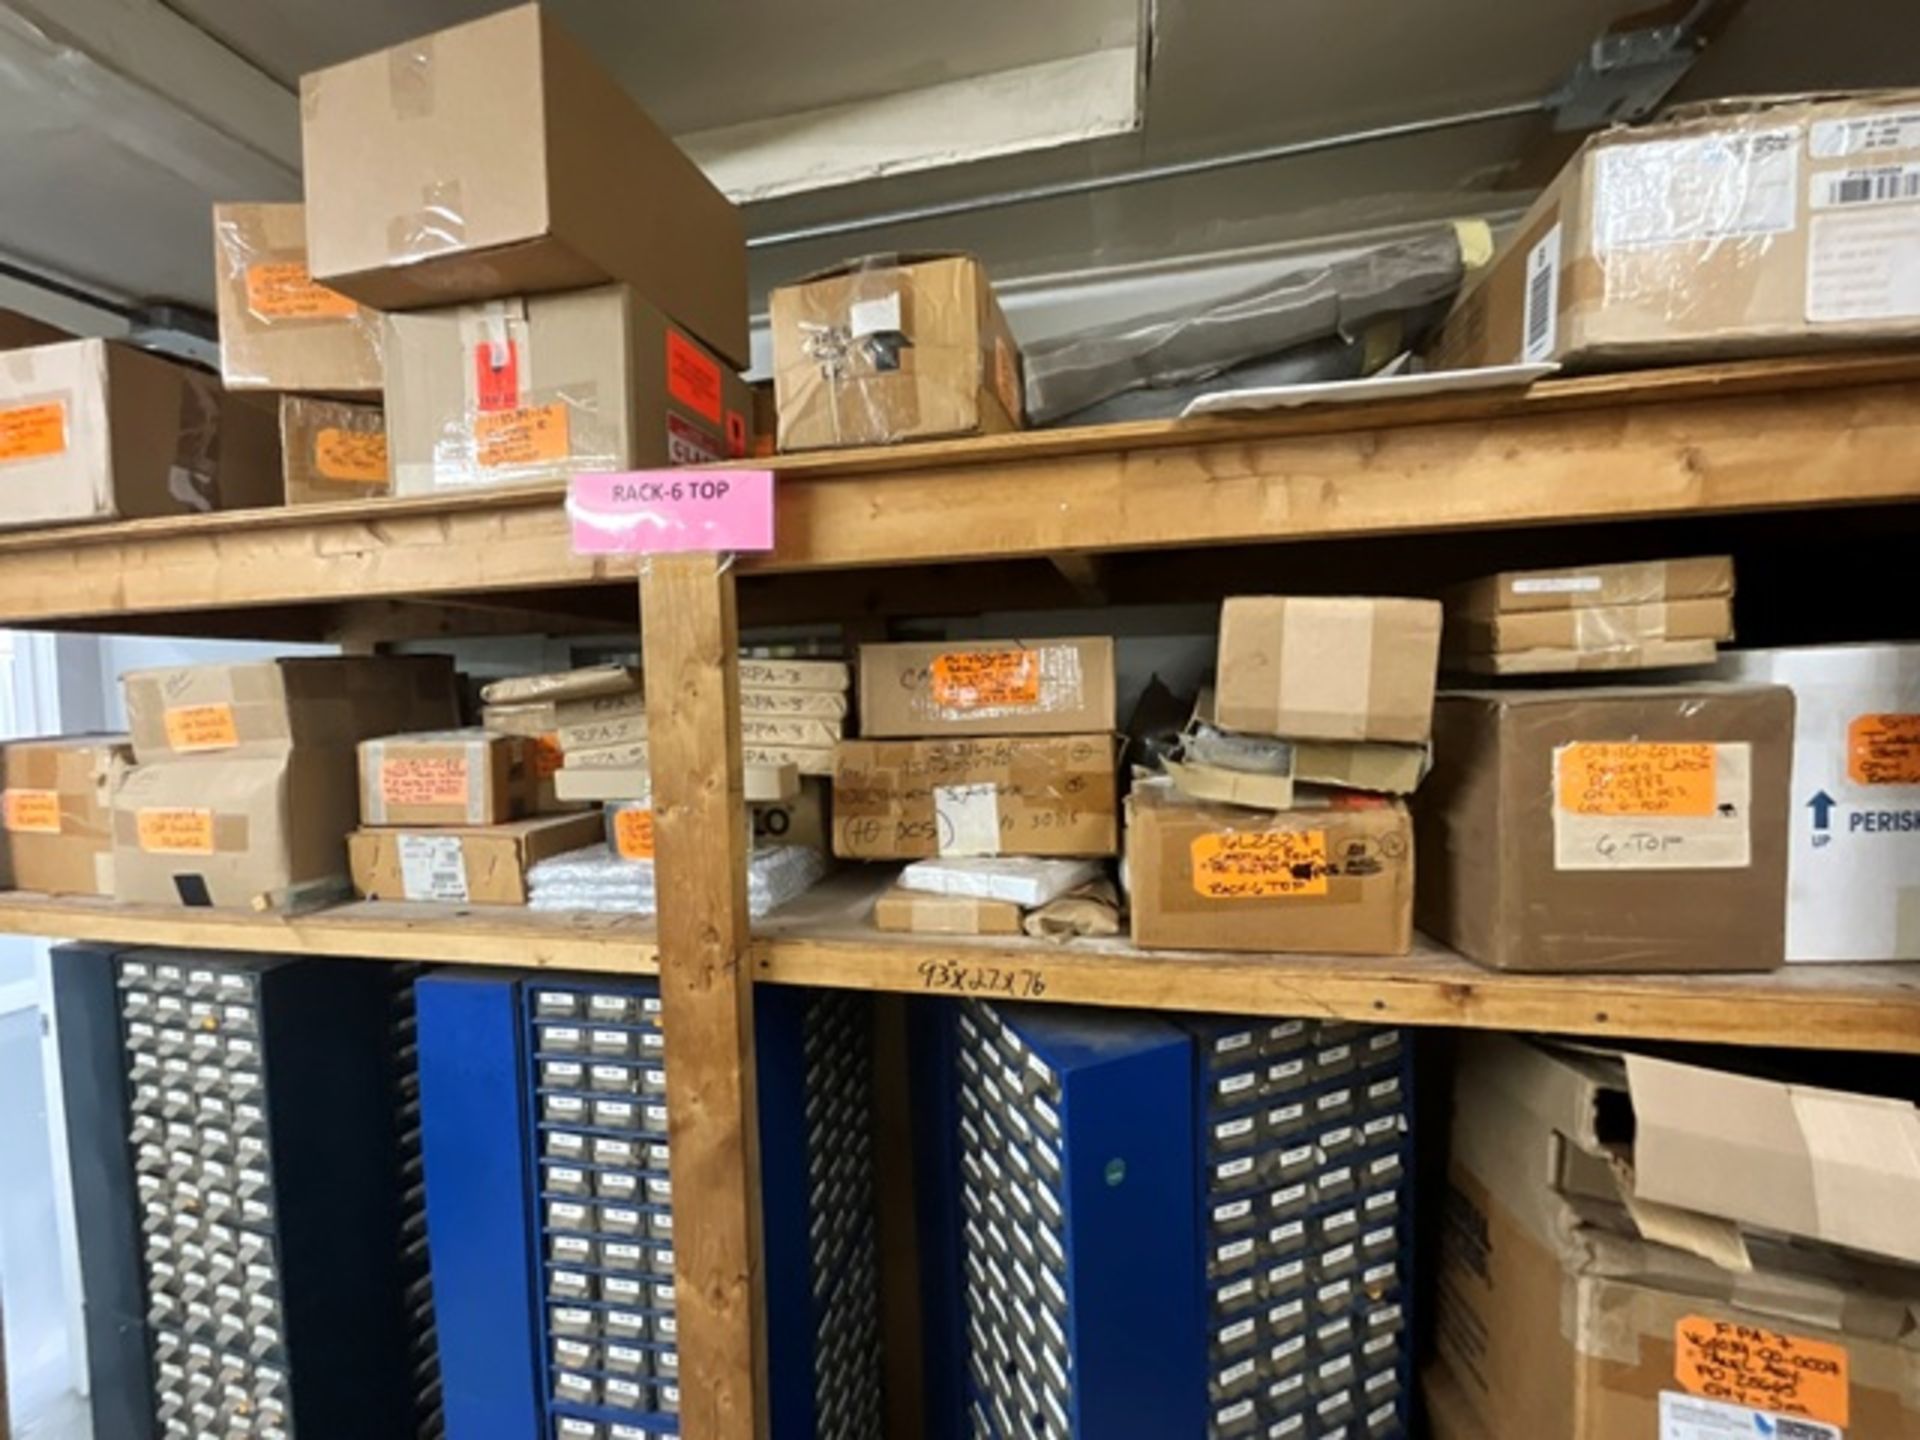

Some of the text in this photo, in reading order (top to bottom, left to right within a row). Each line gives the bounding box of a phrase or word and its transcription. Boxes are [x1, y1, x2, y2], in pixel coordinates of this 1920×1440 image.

[612, 481, 730, 501] RACK-6 TOP
[1811, 834, 1832, 848] UP
